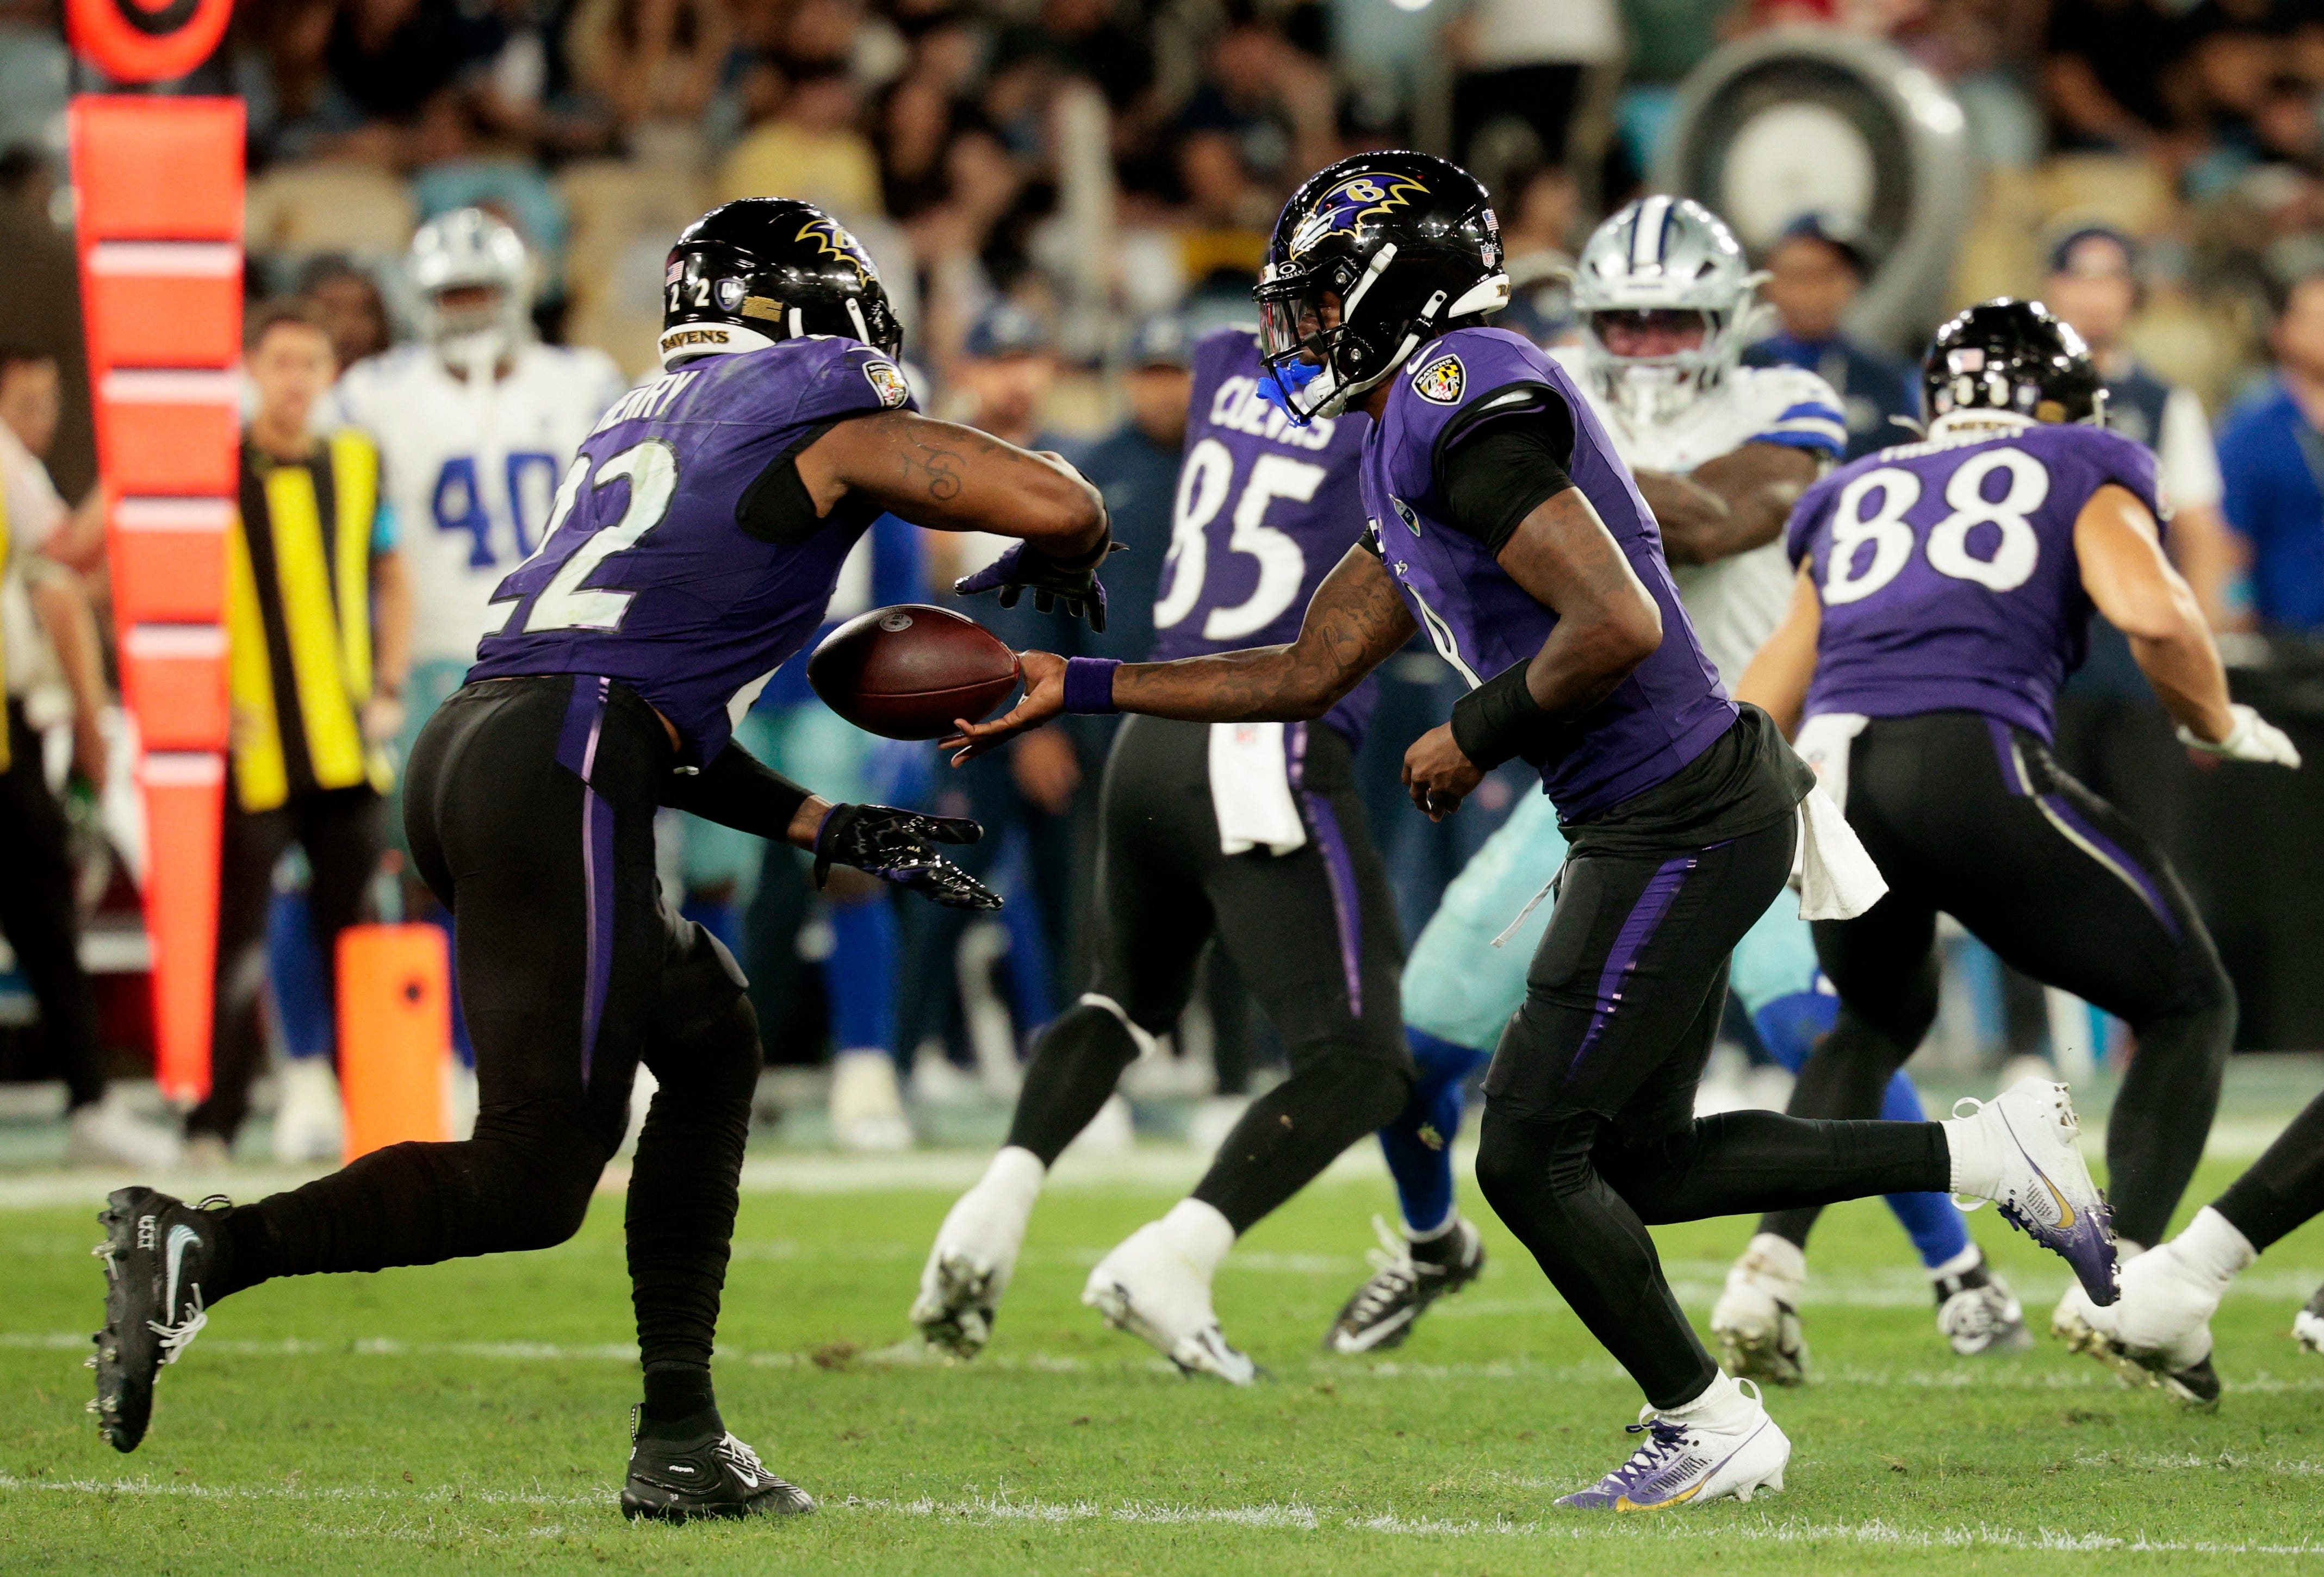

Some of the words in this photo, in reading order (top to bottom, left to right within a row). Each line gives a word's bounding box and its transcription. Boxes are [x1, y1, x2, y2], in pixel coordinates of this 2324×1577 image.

[661, 331, 730, 353] RAVENS
[433, 452, 558, 566] 40
[483, 436, 681, 636] 22
[1153, 437, 1327, 640] 85
[1822, 447, 2049, 604] 88
